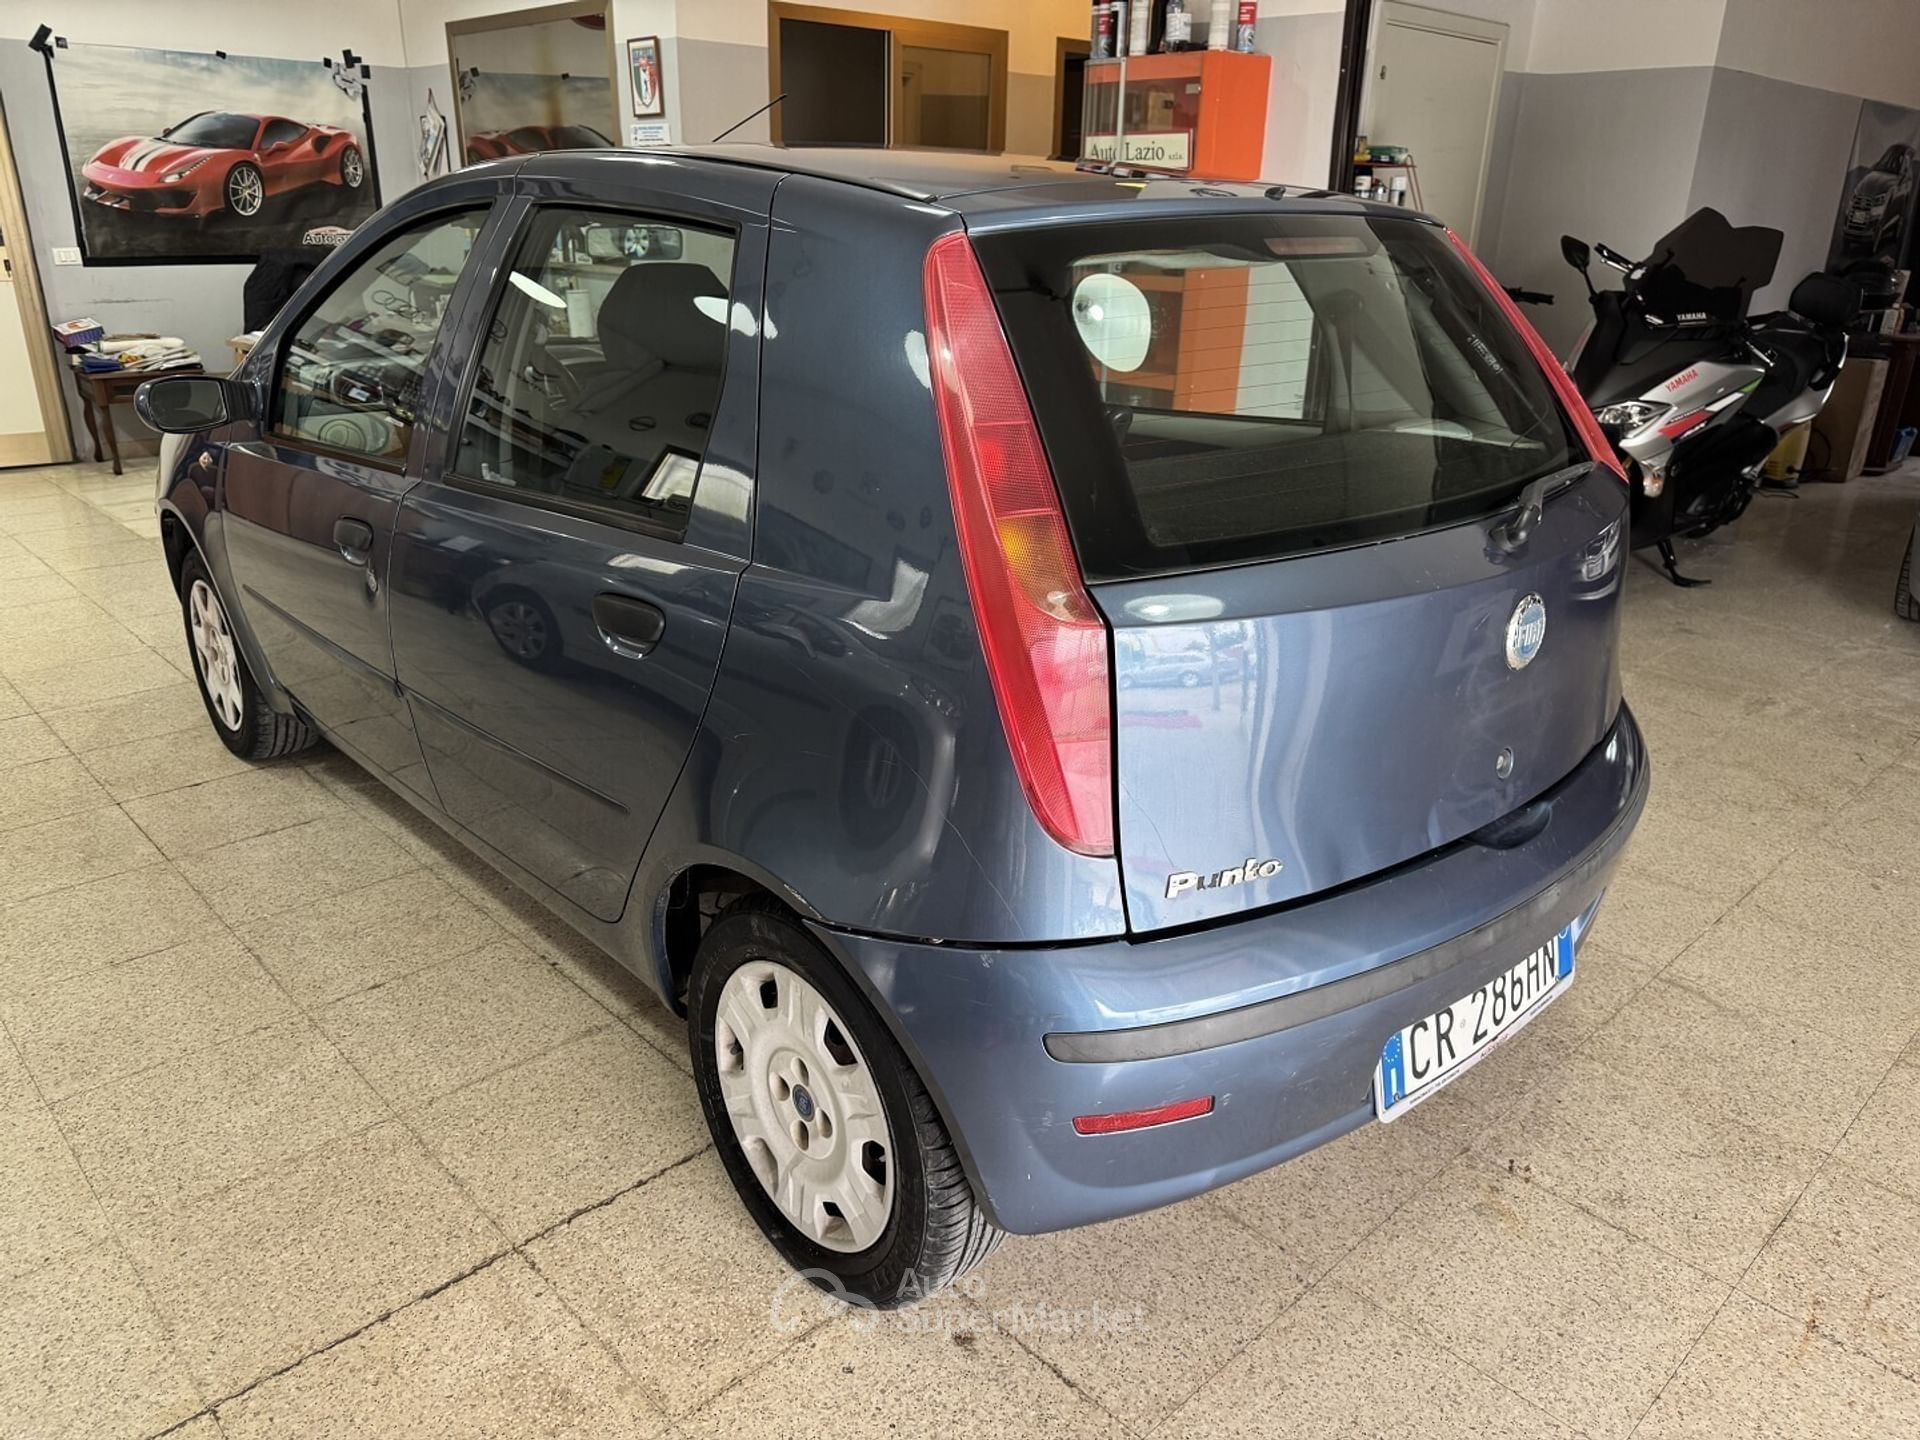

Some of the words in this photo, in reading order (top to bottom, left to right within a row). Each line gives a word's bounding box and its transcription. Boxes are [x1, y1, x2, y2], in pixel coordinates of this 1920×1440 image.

[1125, 141, 1165, 160] Lazio
[1676, 312, 1707, 320] YAMAHA
[1664, 369, 1699, 393] YAMAHA
[1164, 857, 1284, 899] Punto
[1409, 1006, 1456, 1080] CR
[1470, 938, 1556, 1046] 286HN
